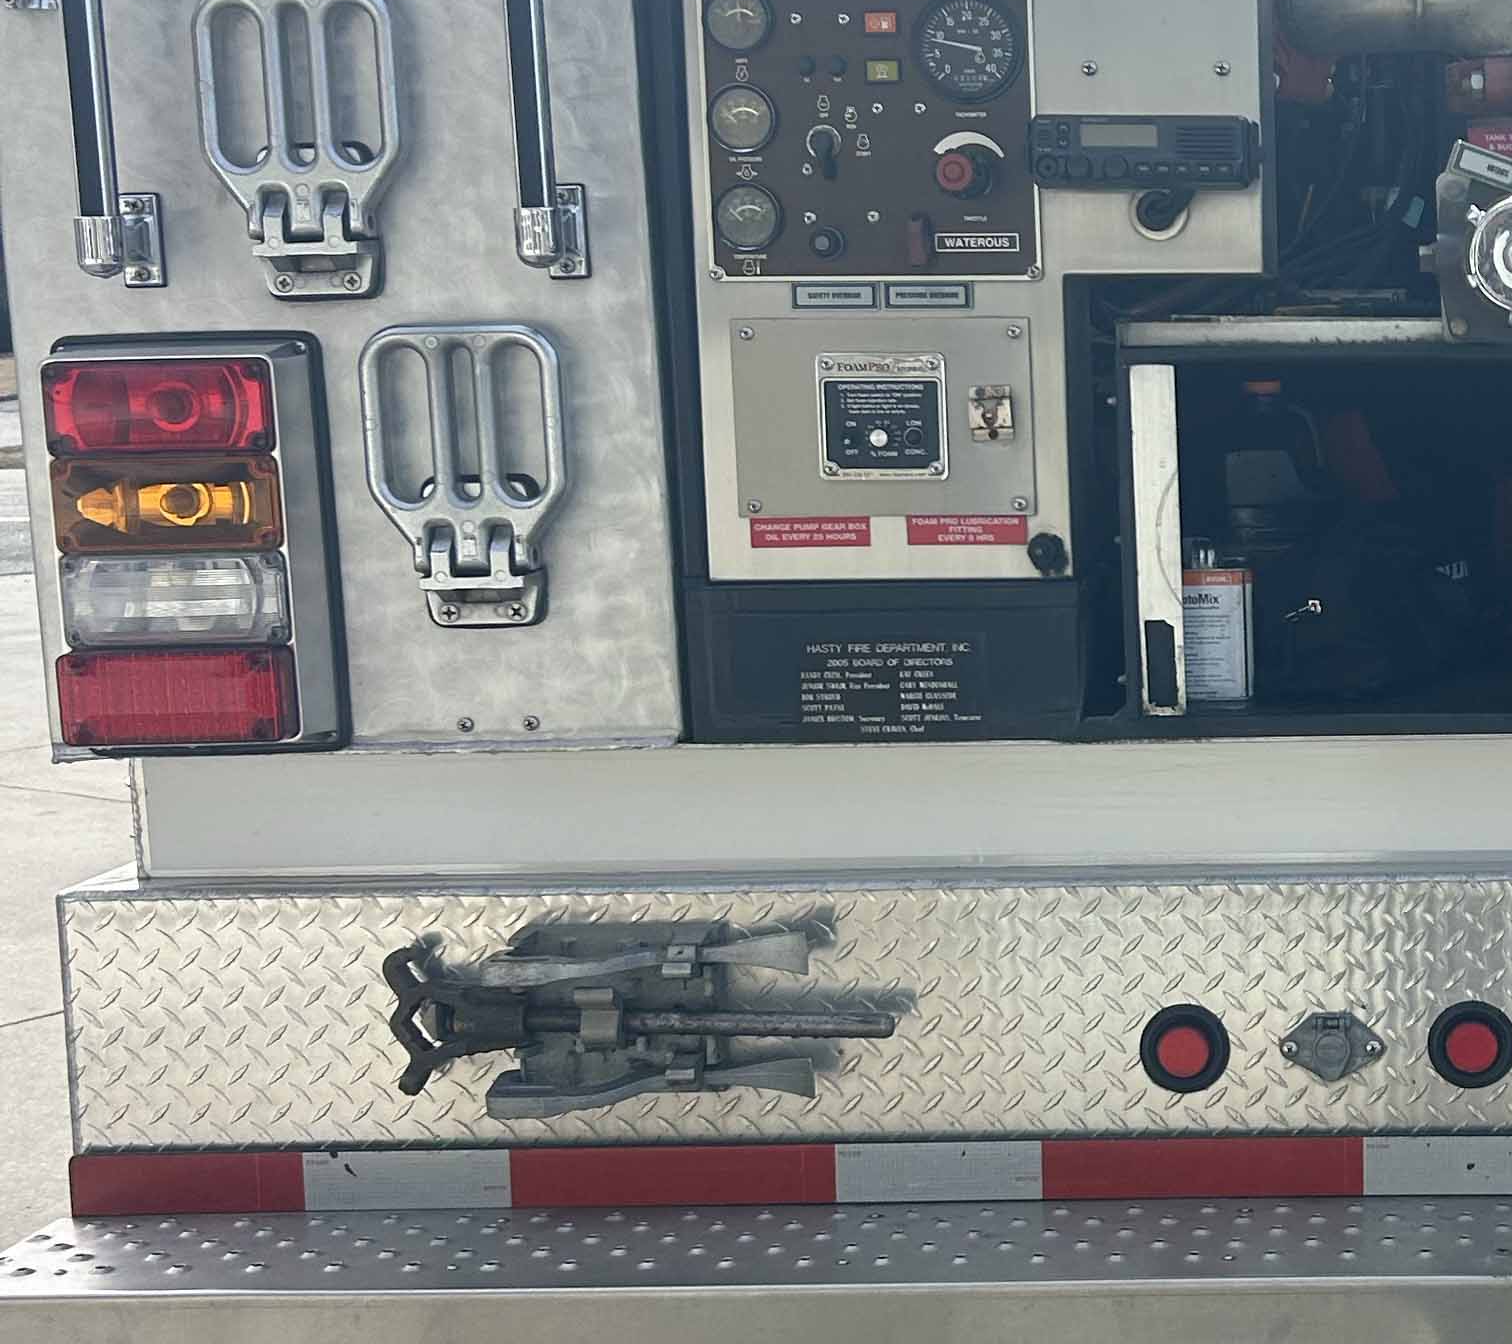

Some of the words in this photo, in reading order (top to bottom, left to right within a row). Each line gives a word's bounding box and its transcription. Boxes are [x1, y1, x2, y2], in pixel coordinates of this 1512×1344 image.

[961, 10, 972, 21] 20
[979, 16, 990, 26] 25
[992, 47, 1003, 58] 35
[944, 64, 951, 74] 0
[985, 64, 997, 73] 40
[1485, 135, 1507, 143] TANK
[944, 237, 1010, 248] WATEROUS
[876, 383, 924, 391] INSTRUCTIONS
[912, 517, 938, 525] FOAM
[940, 517, 959, 525] PRO
[960, 516, 1019, 525] LUBRICATION
[753, 523, 790, 531] CHANGE
[792, 523, 819, 531] PUMP
[821, 522, 845, 531] GEAR
[847, 522, 867, 530] BOX
[949, 525, 983, 533] FITTING
[765, 533, 779, 541] OIL
[782, 533, 810, 541] EVERY
[937, 534, 966, 542] EVERY
[1183, 593, 1220, 605] otoMix
[806, 643, 842, 654] HASTY
[847, 643, 872, 654] FIRE
[827, 658, 849, 667] 2005
[852, 658, 884, 667] BOARD
[887, 658, 899, 667] OF
[903, 657, 953, 667] DIRECTORS
